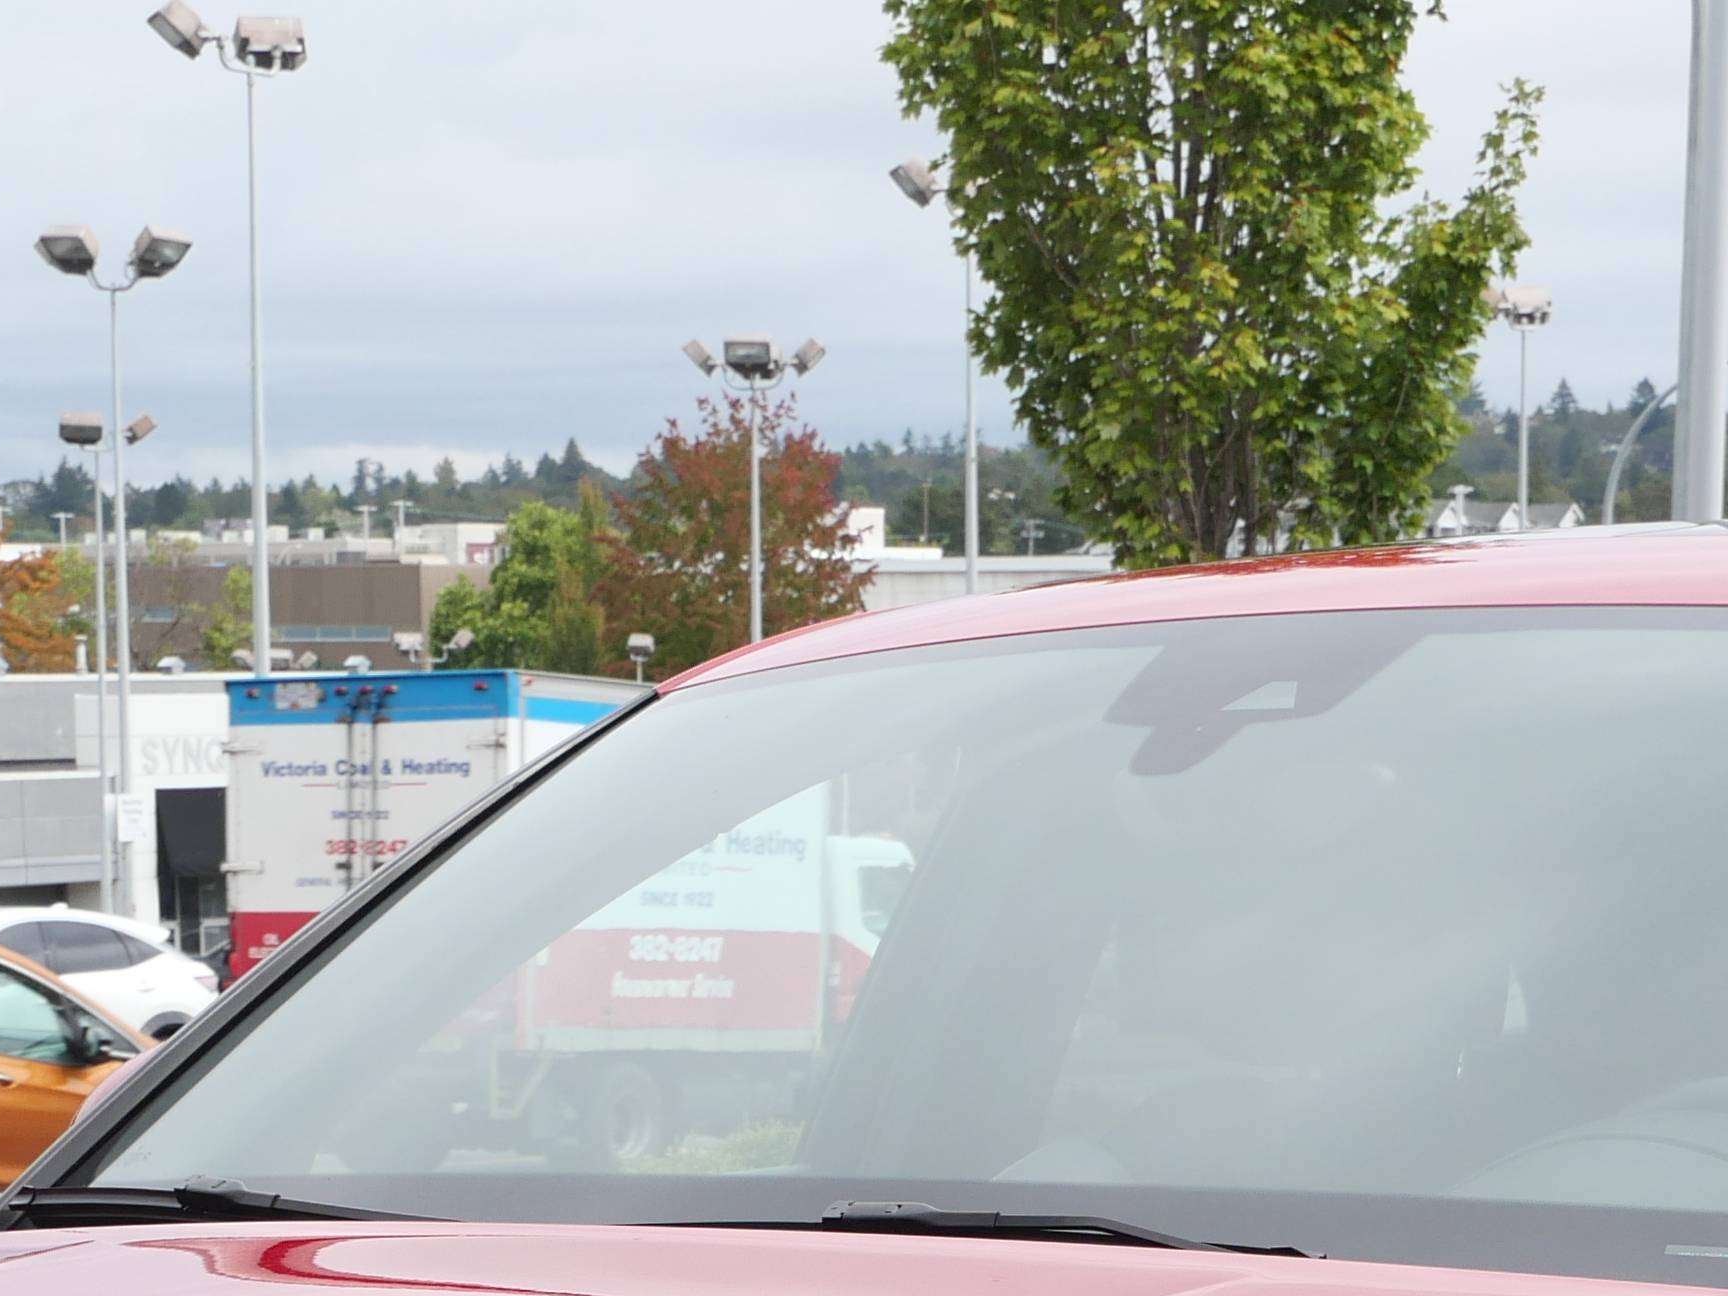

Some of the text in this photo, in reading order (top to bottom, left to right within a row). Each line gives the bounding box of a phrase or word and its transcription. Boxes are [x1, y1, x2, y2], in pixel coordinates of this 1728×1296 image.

[261, 759, 327, 777] Victoria
[381, 759, 392, 776] &
[402, 758, 471, 778] Heating
[726, 831, 806, 861] Heating
